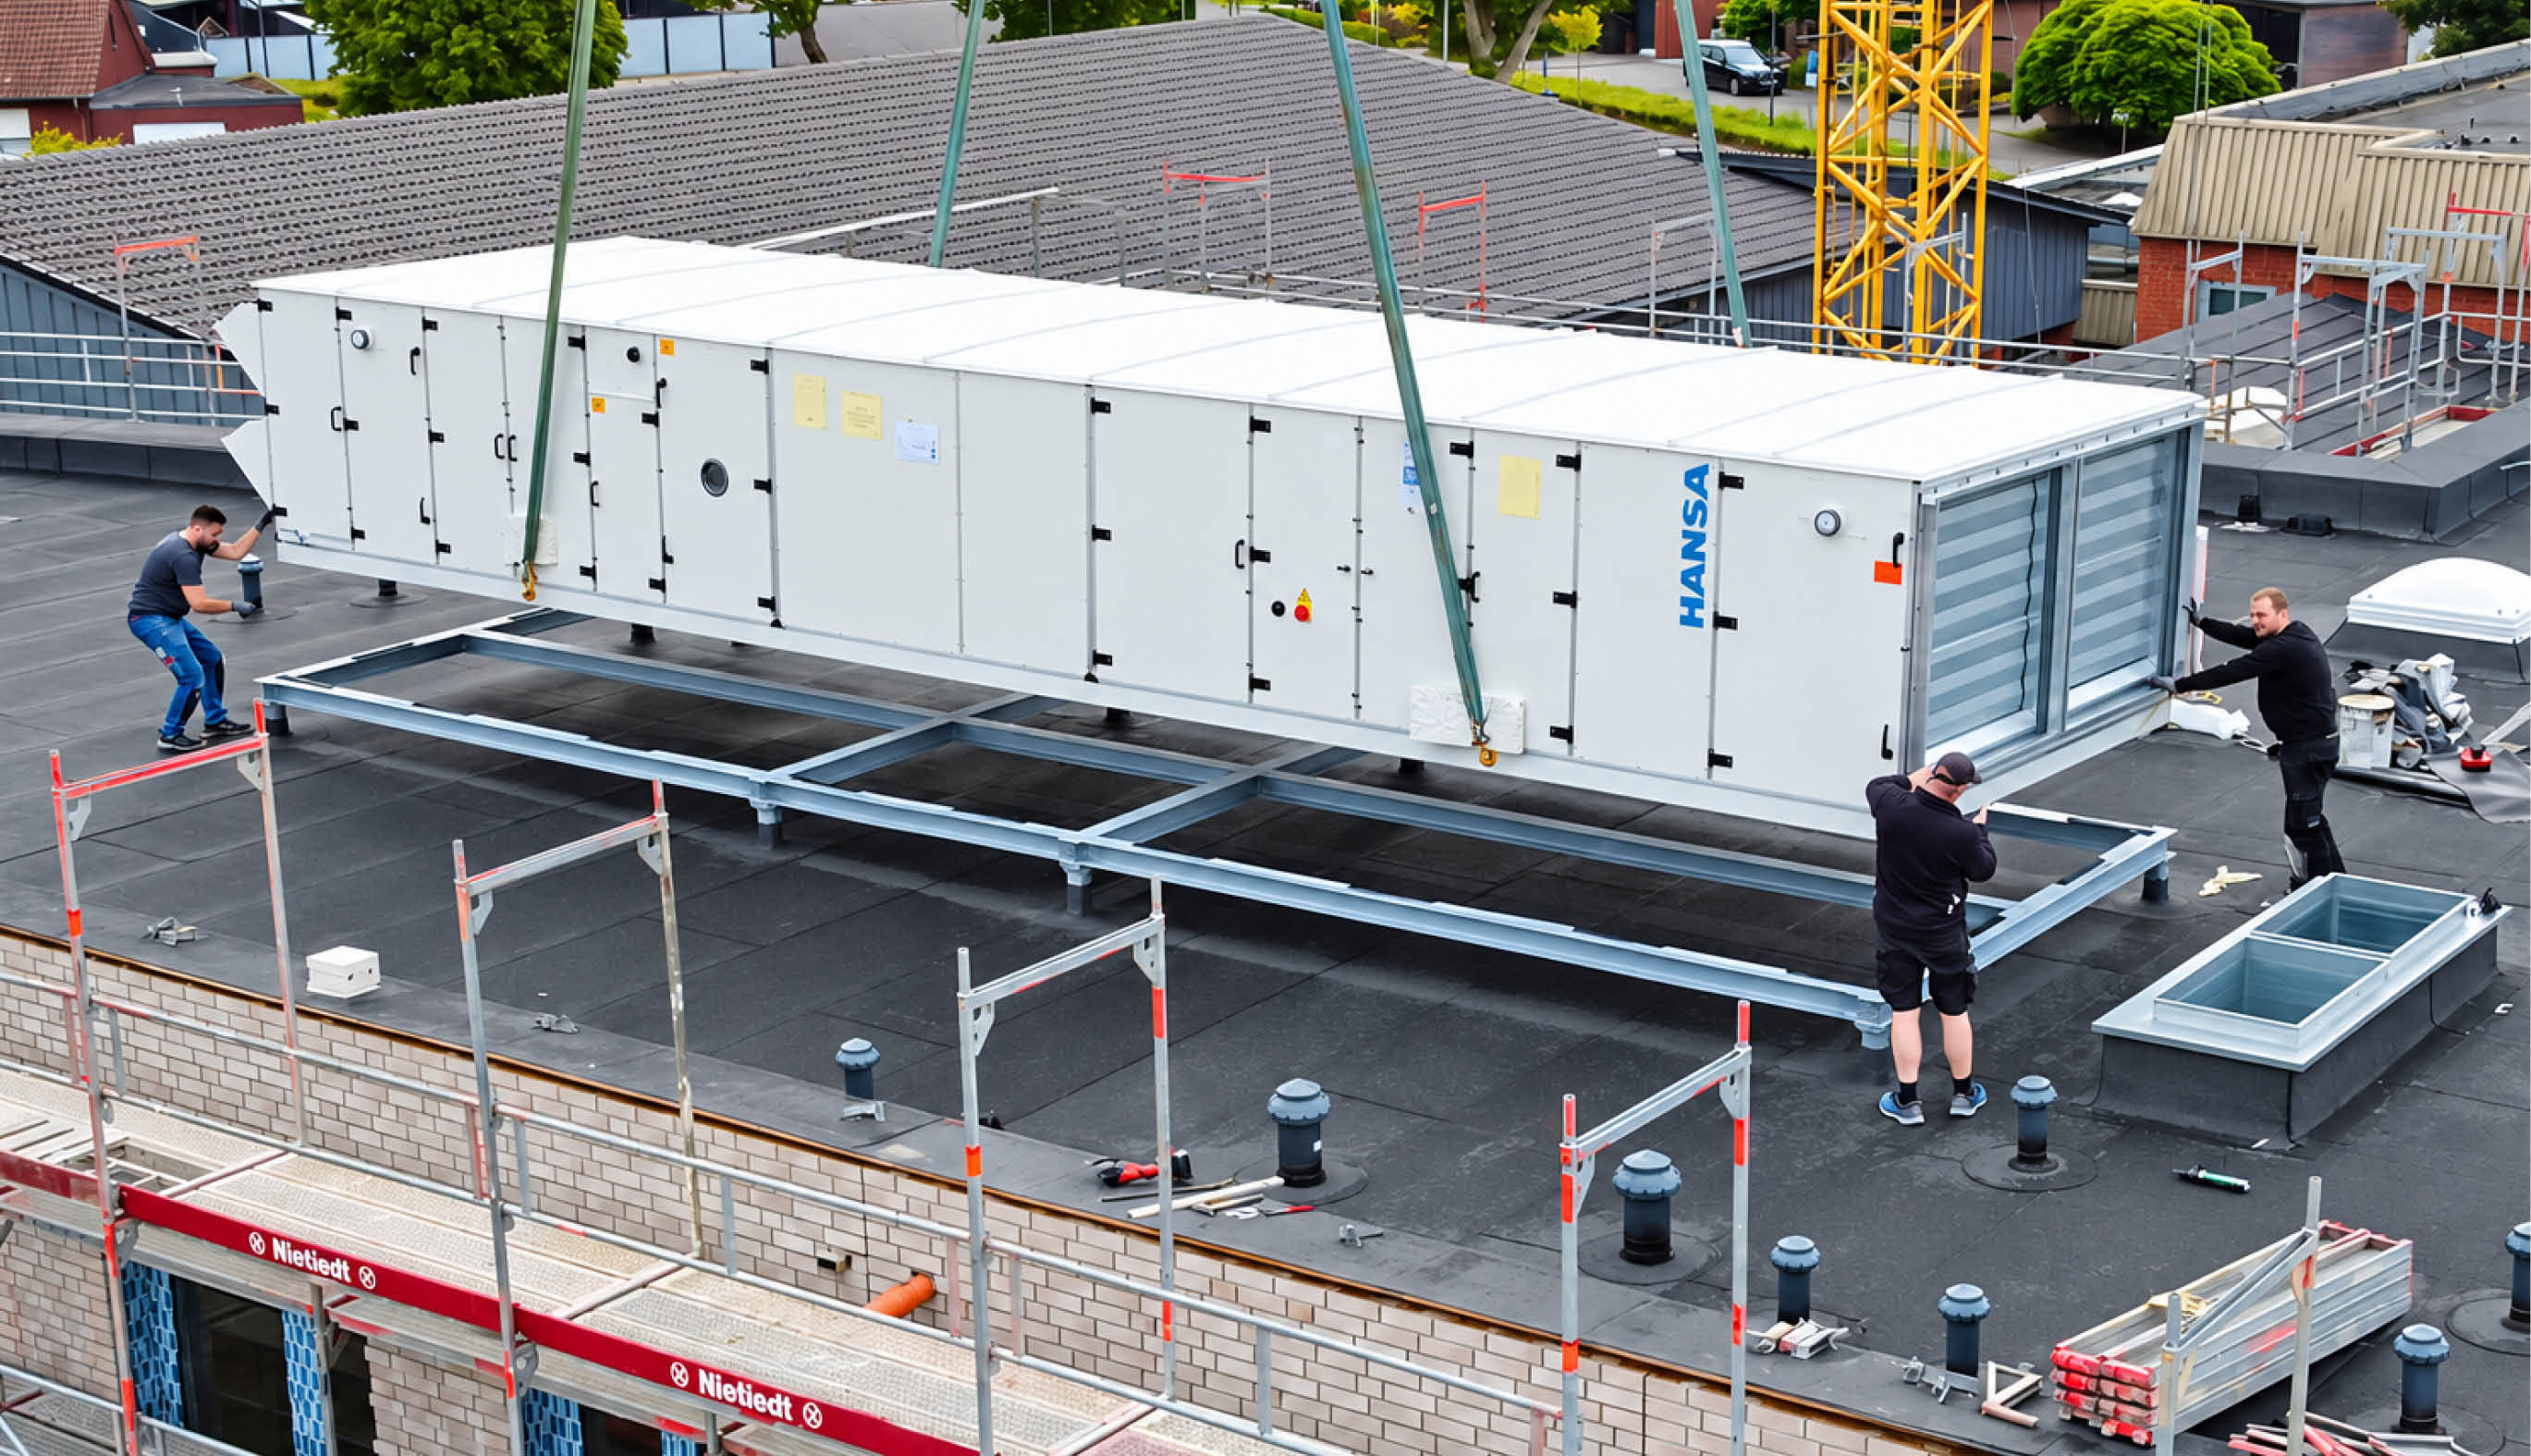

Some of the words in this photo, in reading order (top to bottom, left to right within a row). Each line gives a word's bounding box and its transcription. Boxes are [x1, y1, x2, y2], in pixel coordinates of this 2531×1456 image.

[1680, 463, 1709, 629] HANSA
[272, 1238, 350, 1282] Nietiedt
[698, 1369, 792, 1421] Nietiedt
